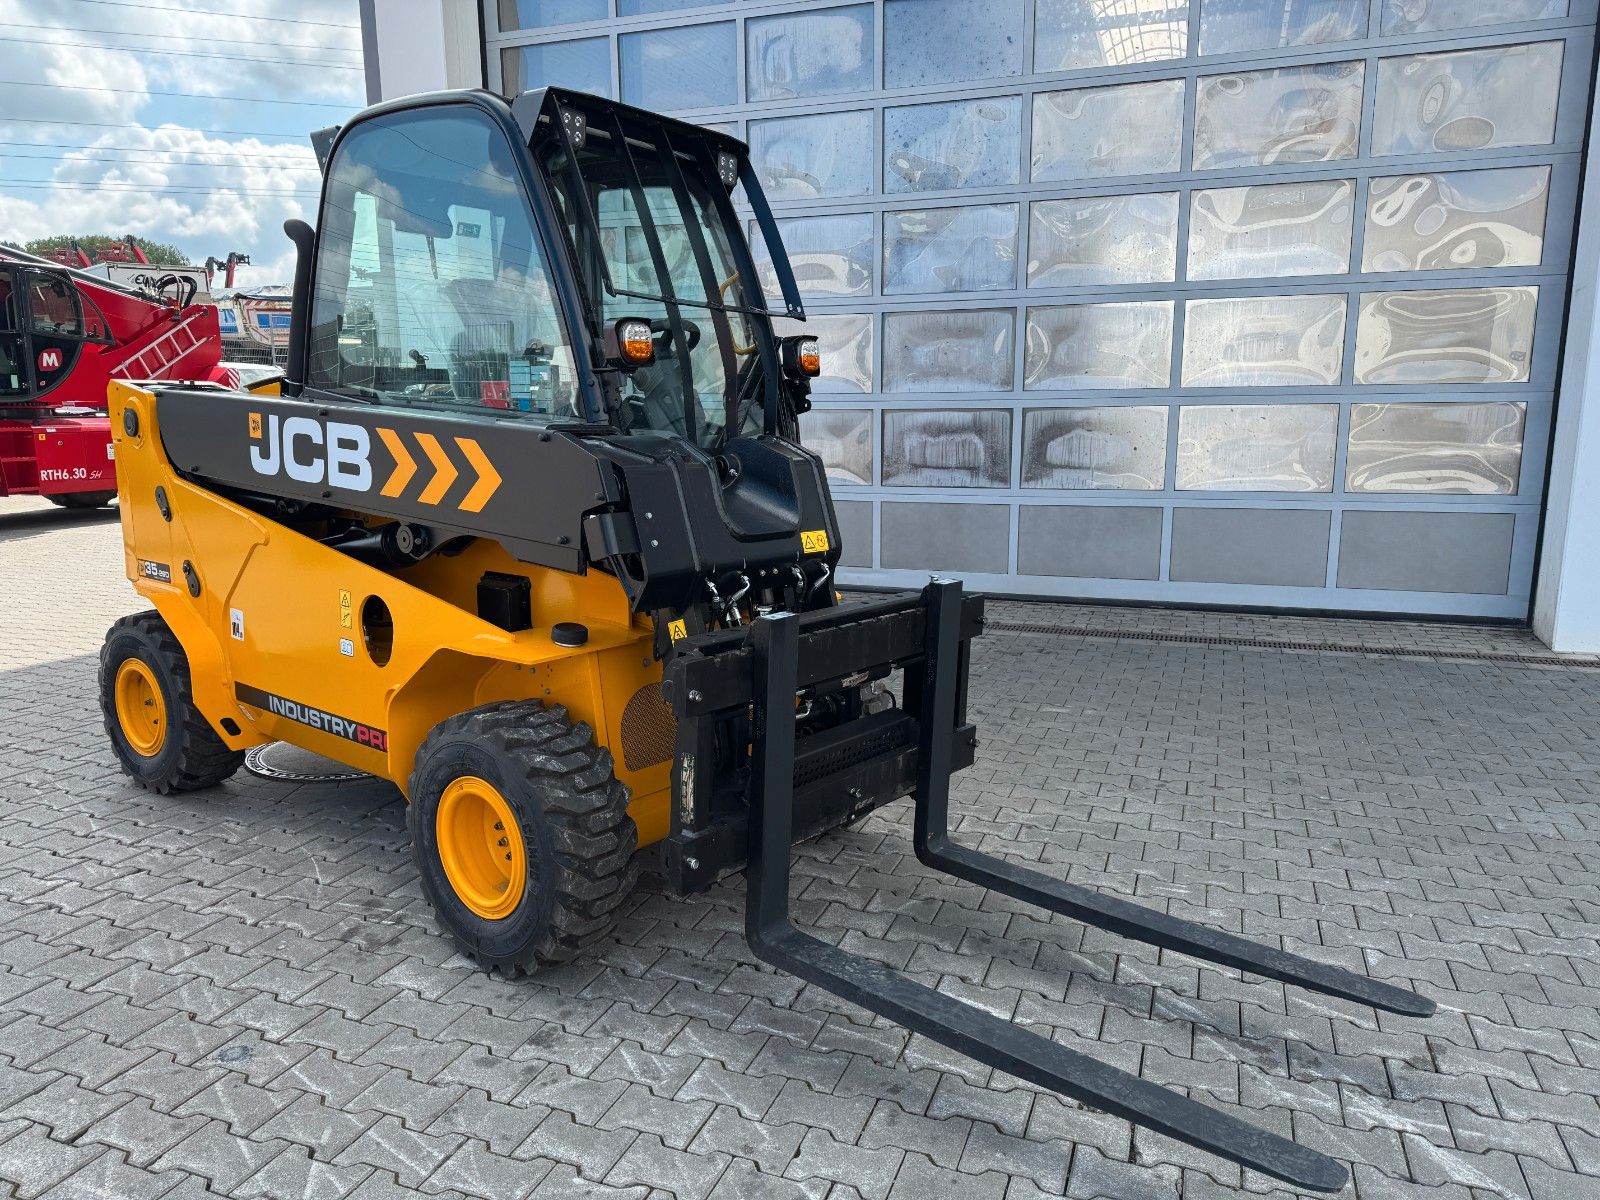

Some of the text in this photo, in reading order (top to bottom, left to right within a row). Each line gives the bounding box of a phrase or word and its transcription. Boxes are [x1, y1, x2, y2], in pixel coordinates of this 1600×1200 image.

[43, 353, 58, 367] M
[249, 412, 373, 492] JCB
[40, 467, 88, 482] RTH6.30
